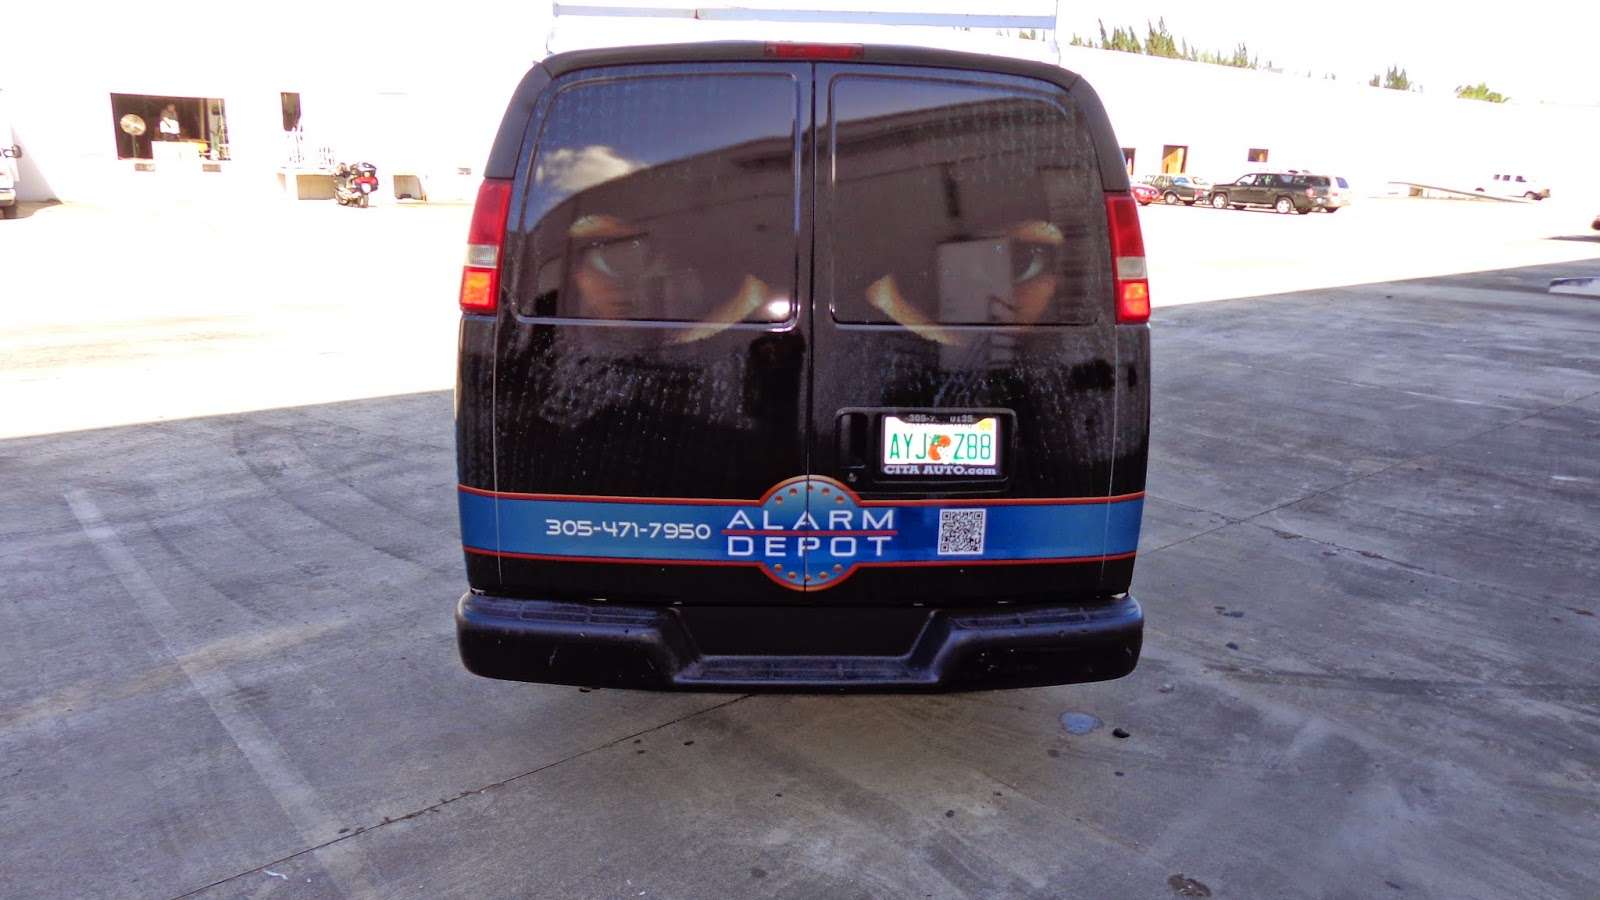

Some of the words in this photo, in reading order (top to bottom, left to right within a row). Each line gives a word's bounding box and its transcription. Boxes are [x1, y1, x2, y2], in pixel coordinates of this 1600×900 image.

[889, 433, 927, 459] AYJ
[953, 433, 992, 460] Z88
[883, 465, 920, 475] CITA
[922, 465, 996, 475] AUTO.com
[546, 519, 711, 540] 305-471-7950
[726, 509, 894, 530] ALARM
[727, 536, 892, 557] DEPOT
